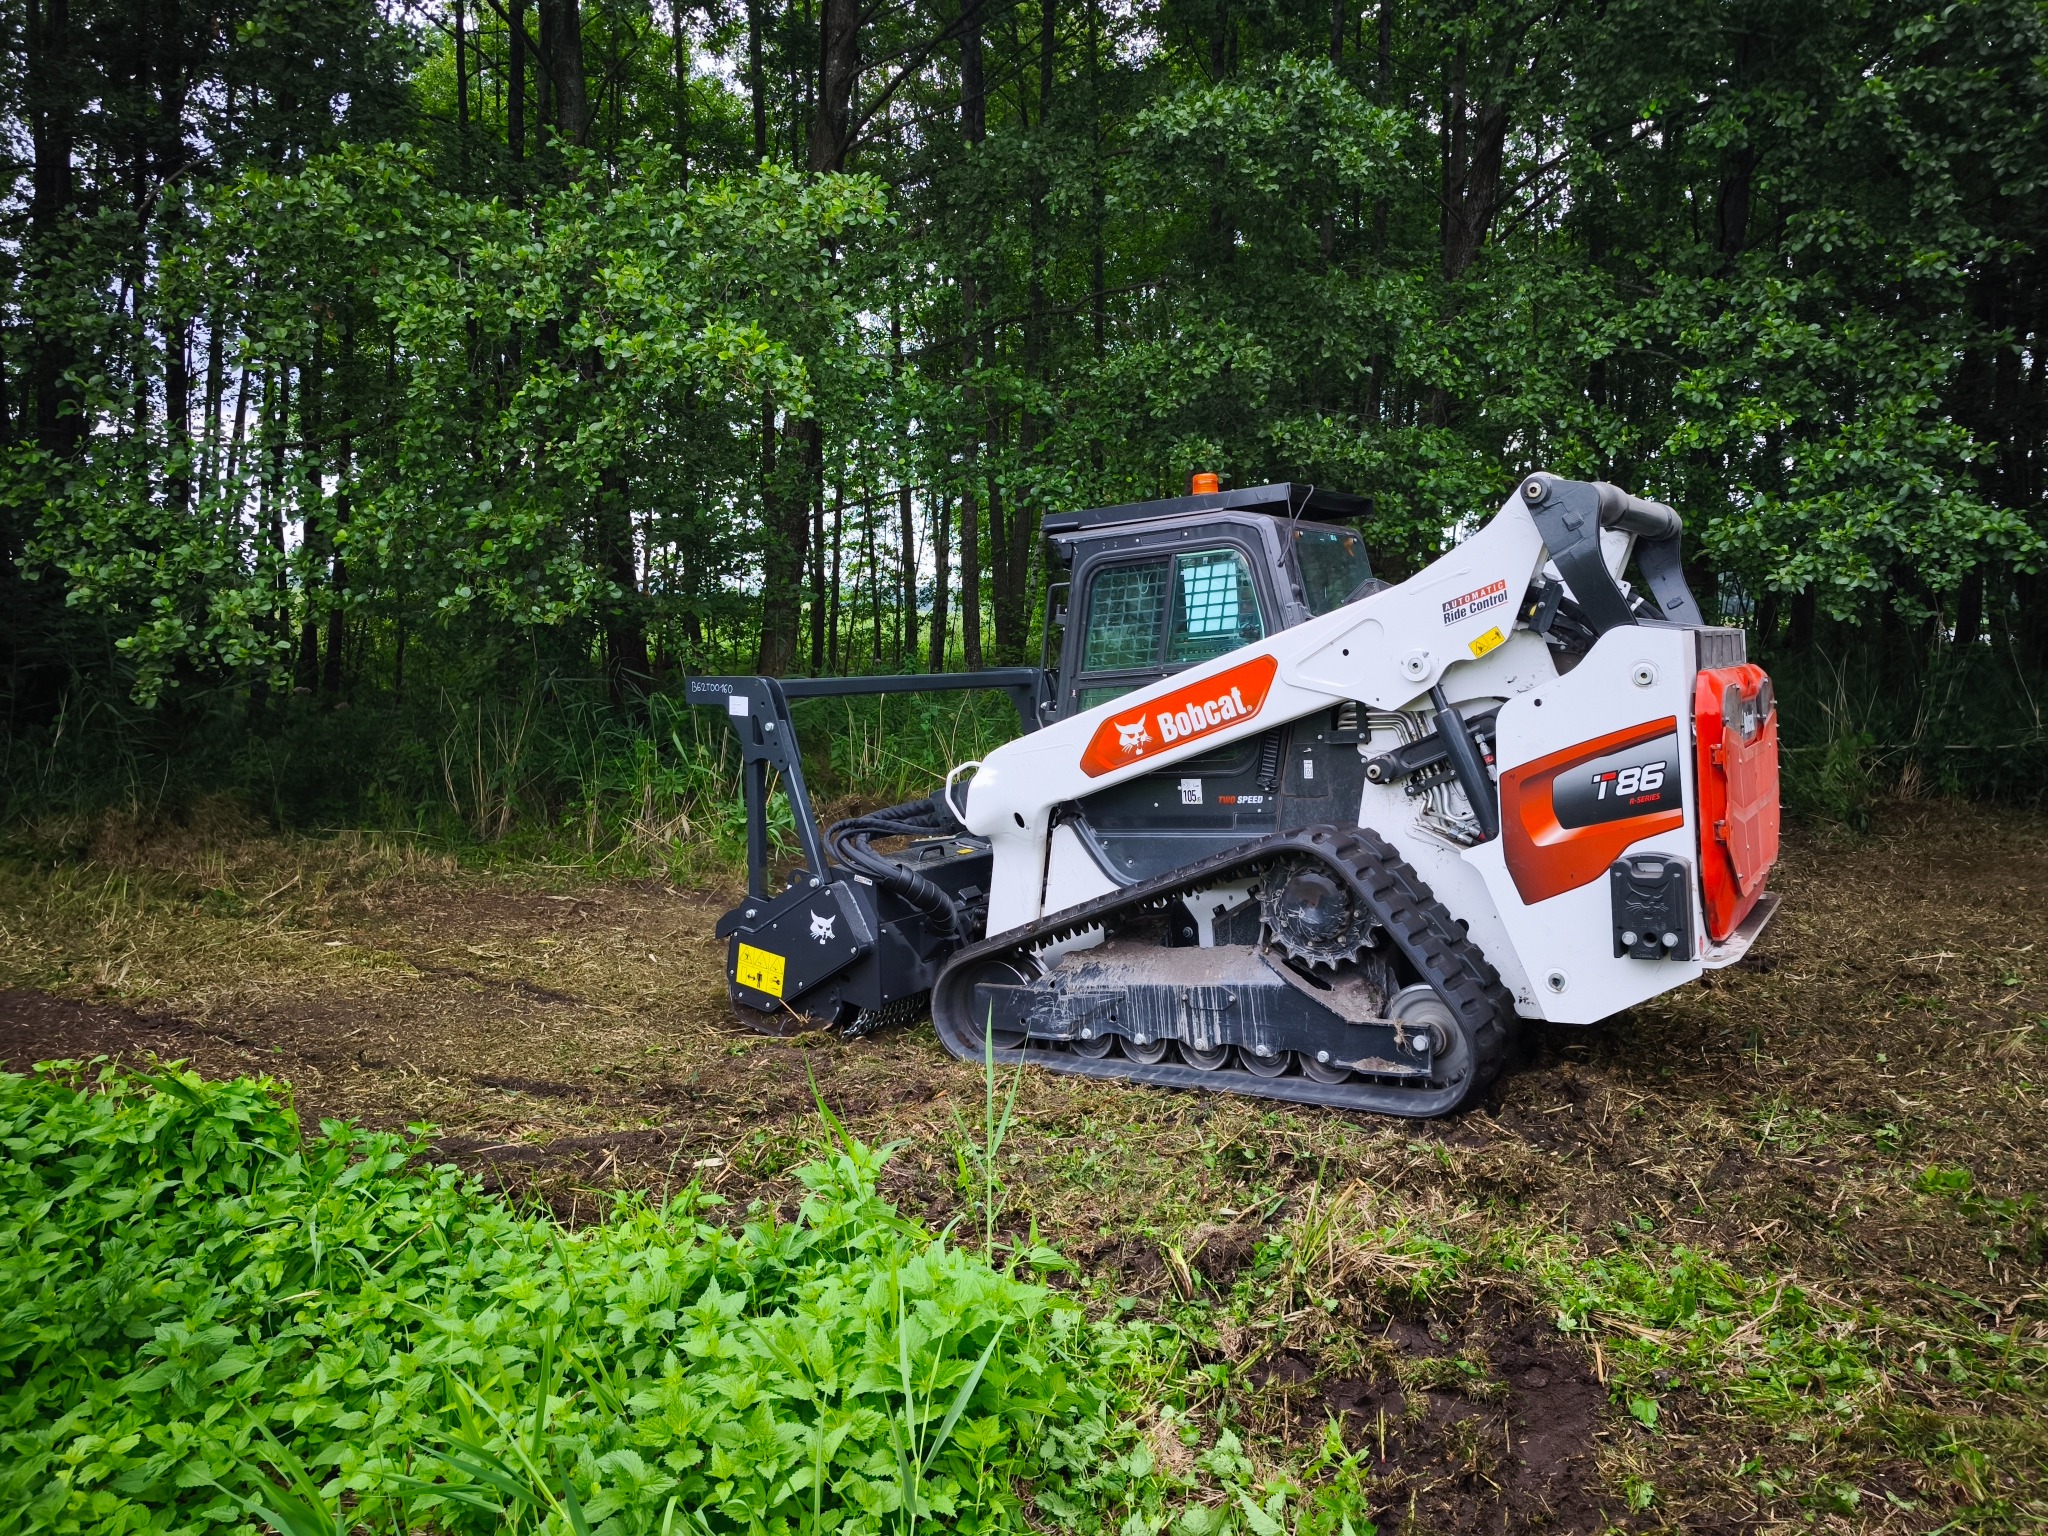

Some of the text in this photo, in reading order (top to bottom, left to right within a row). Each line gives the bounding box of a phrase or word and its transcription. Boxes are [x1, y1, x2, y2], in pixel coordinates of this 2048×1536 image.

[1443, 589, 1508, 624] Ride Control
[1445, 581, 1504, 611] AUTOMATIC
[1157, 686, 1247, 743] Bobcat
[1591, 760, 1667, 800] T86
[1183, 789, 1197, 802] 105
[1218, 795, 1264, 804] TWO SPEED
[1629, 793, 1661, 805] R-SERIES
